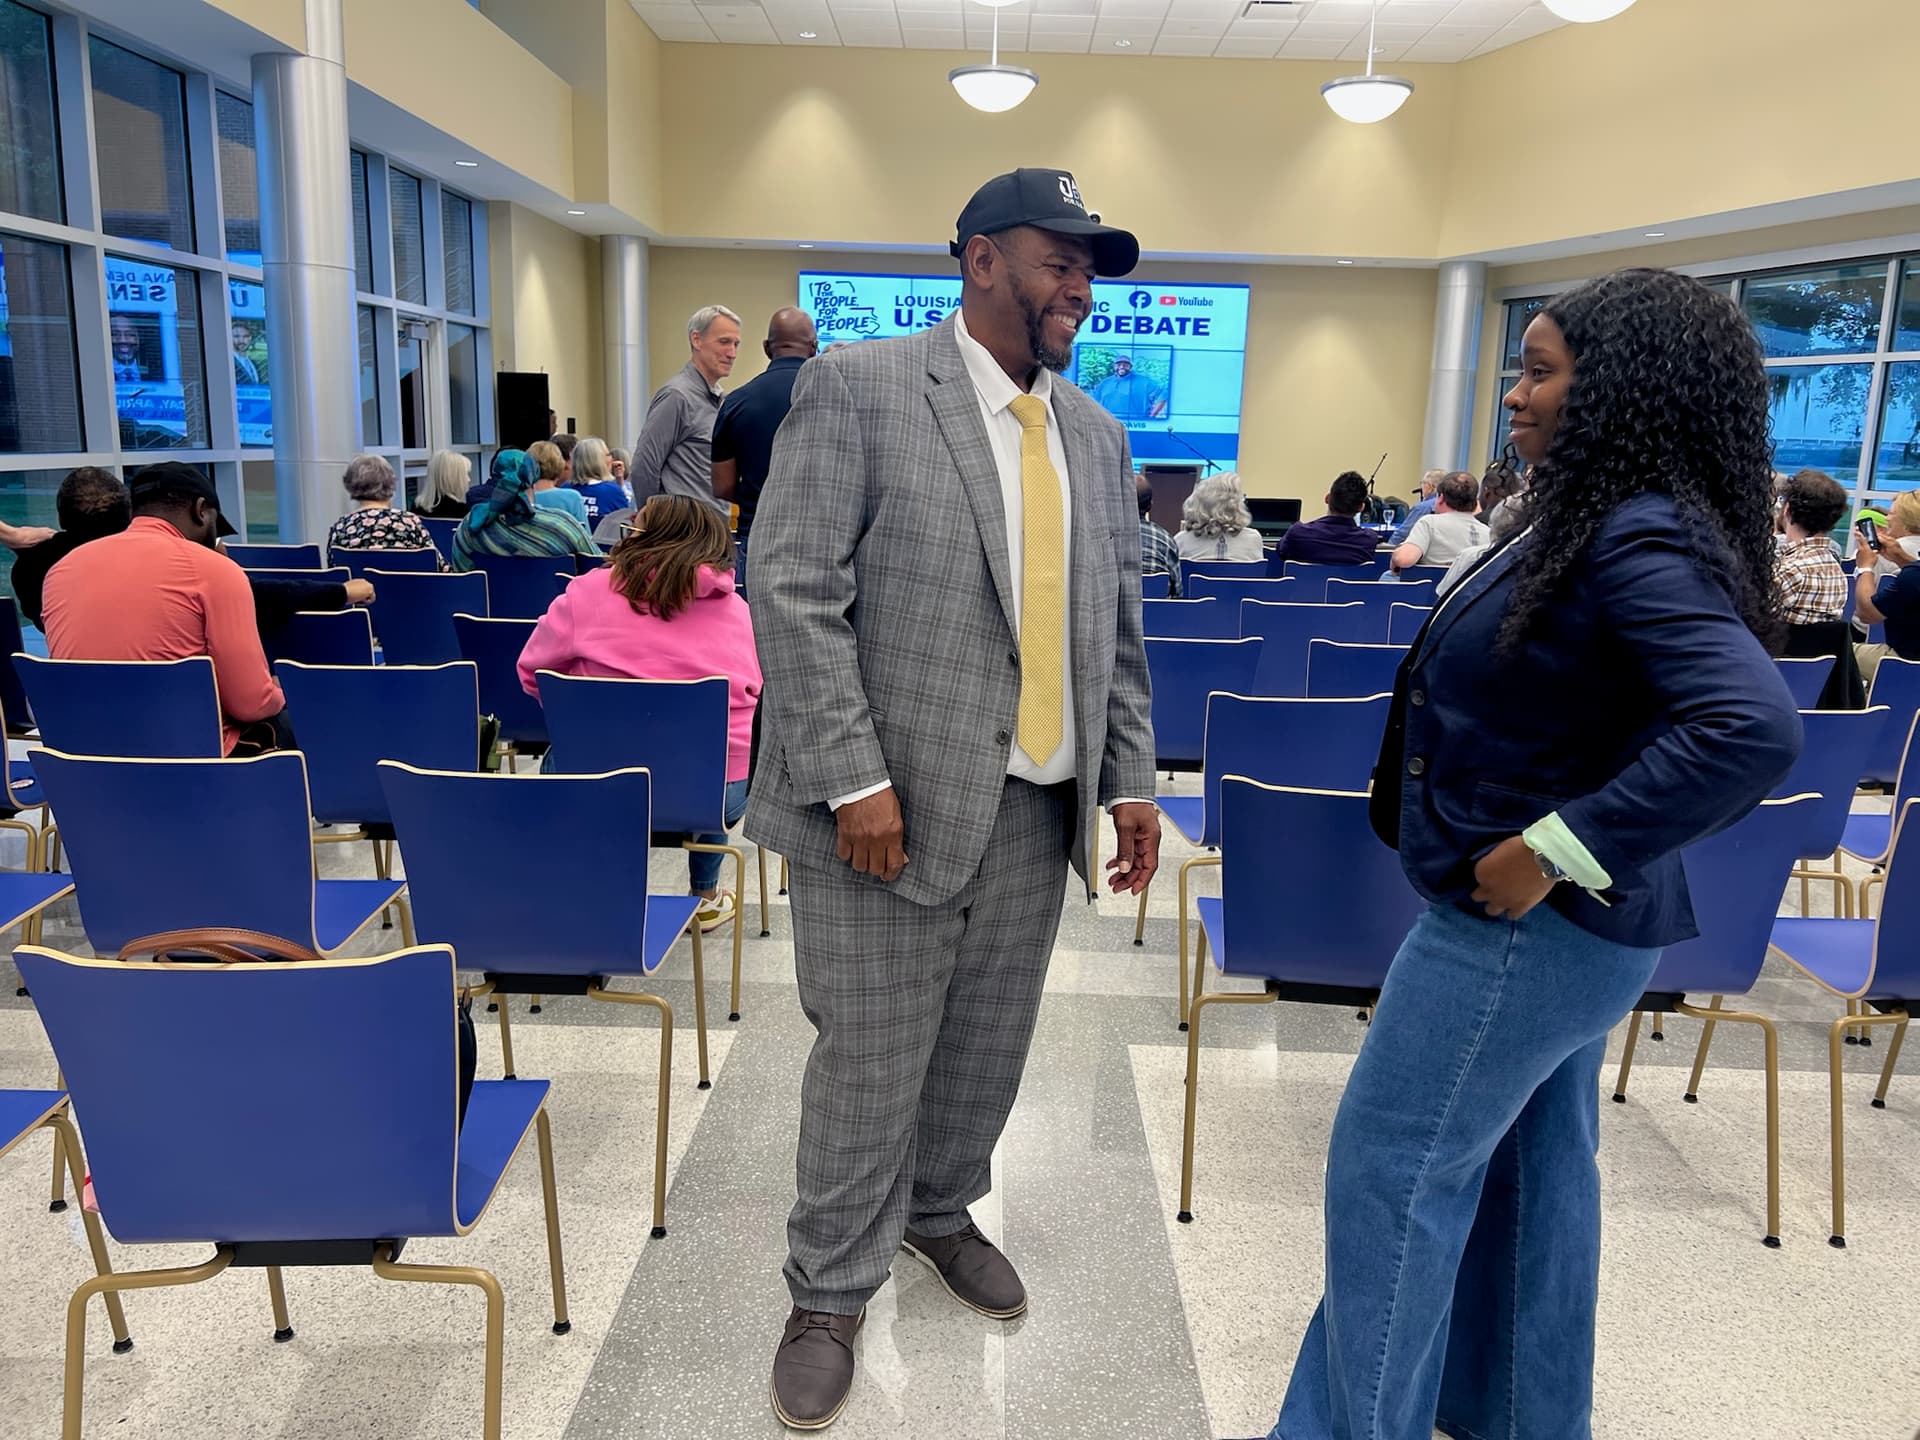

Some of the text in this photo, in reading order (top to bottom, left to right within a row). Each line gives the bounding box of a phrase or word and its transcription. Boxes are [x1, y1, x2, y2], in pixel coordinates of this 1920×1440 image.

[895, 295, 962, 308] LOUISIA
[1178, 296, 1214, 307] YouTube
[819, 308, 838, 317] FOR
[815, 317, 870, 332] PEOPLE
[1091, 315, 1212, 336] DEBATE
